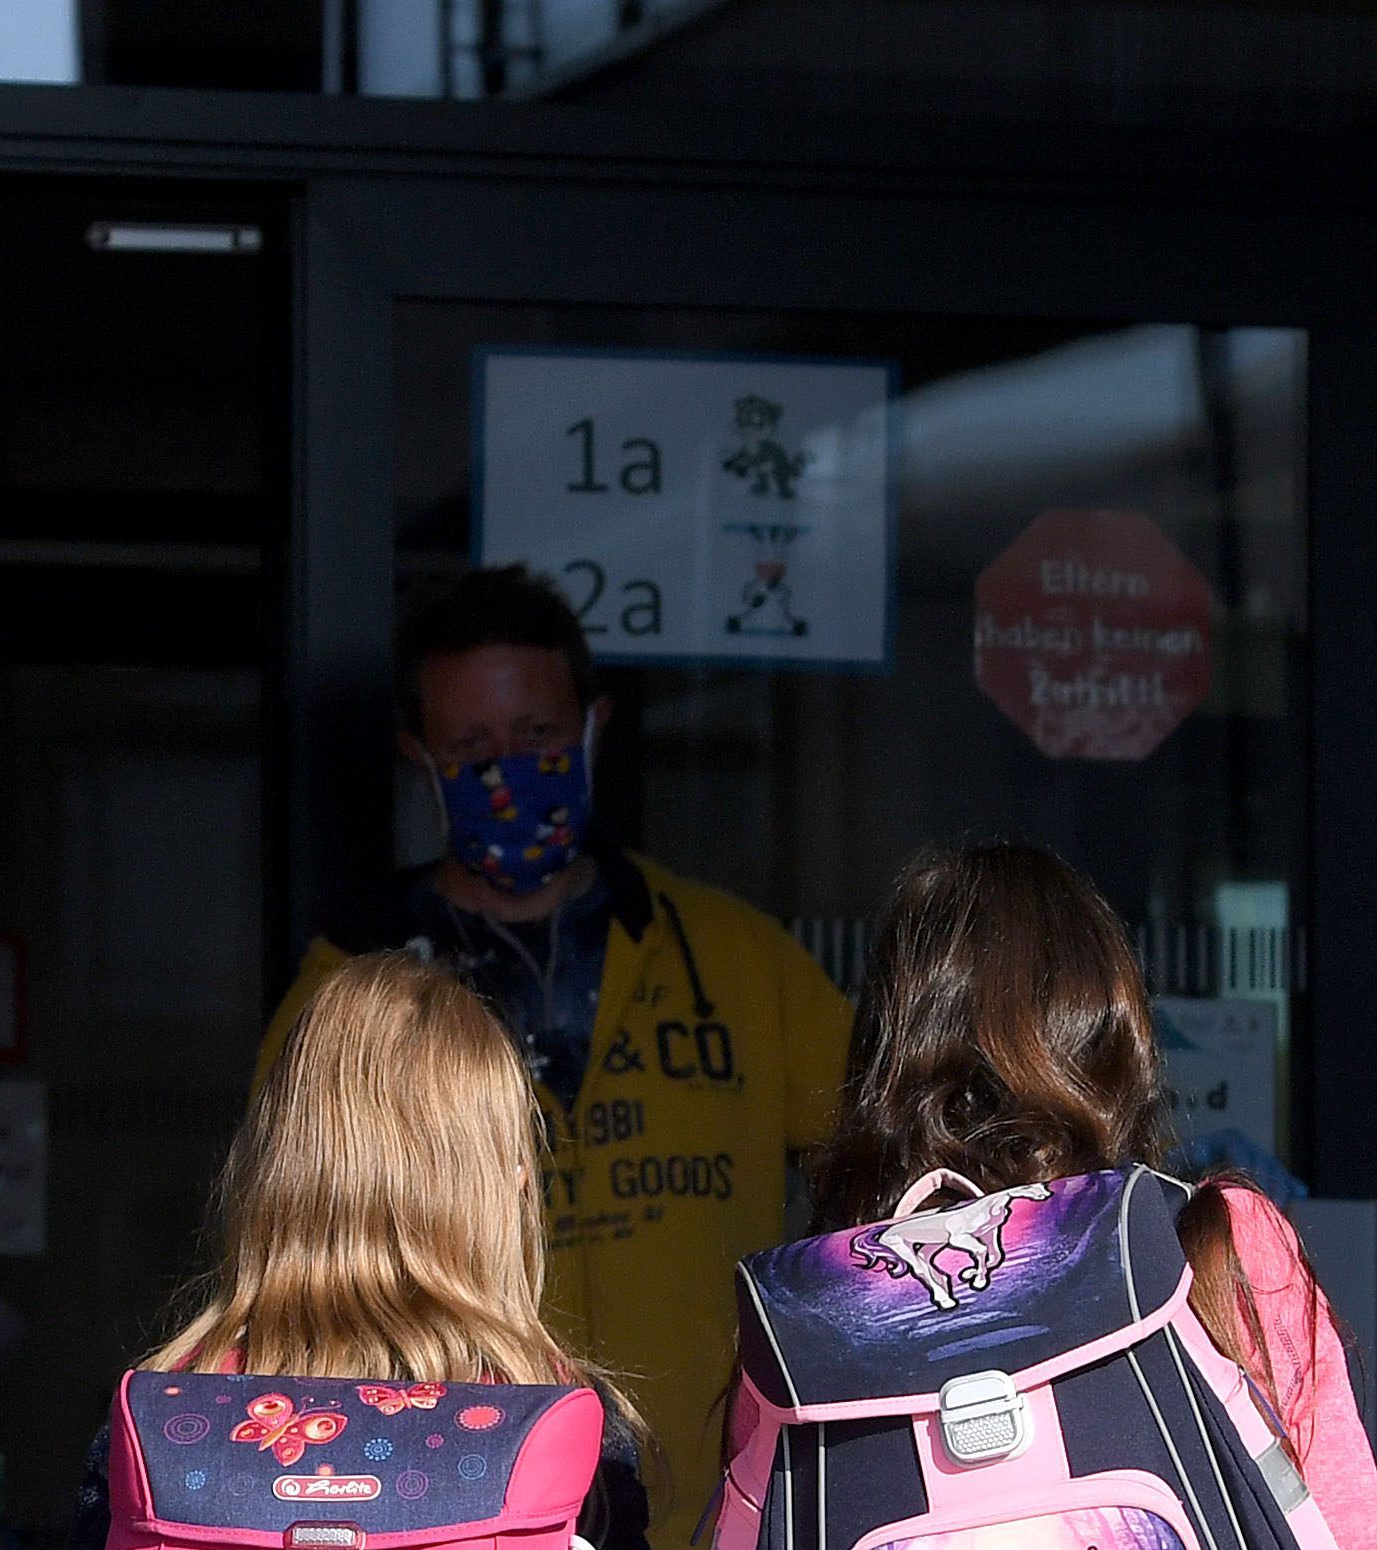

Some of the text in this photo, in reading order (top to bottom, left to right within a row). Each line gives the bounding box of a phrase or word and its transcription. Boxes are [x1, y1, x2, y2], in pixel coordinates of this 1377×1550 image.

[566, 418, 662, 494] 1a
[565, 560, 662, 635] 2a
[1039, 558, 1152, 597] Eltern
[603, 1030, 645, 1075] &
[611, 1153, 734, 1201] GOODS
